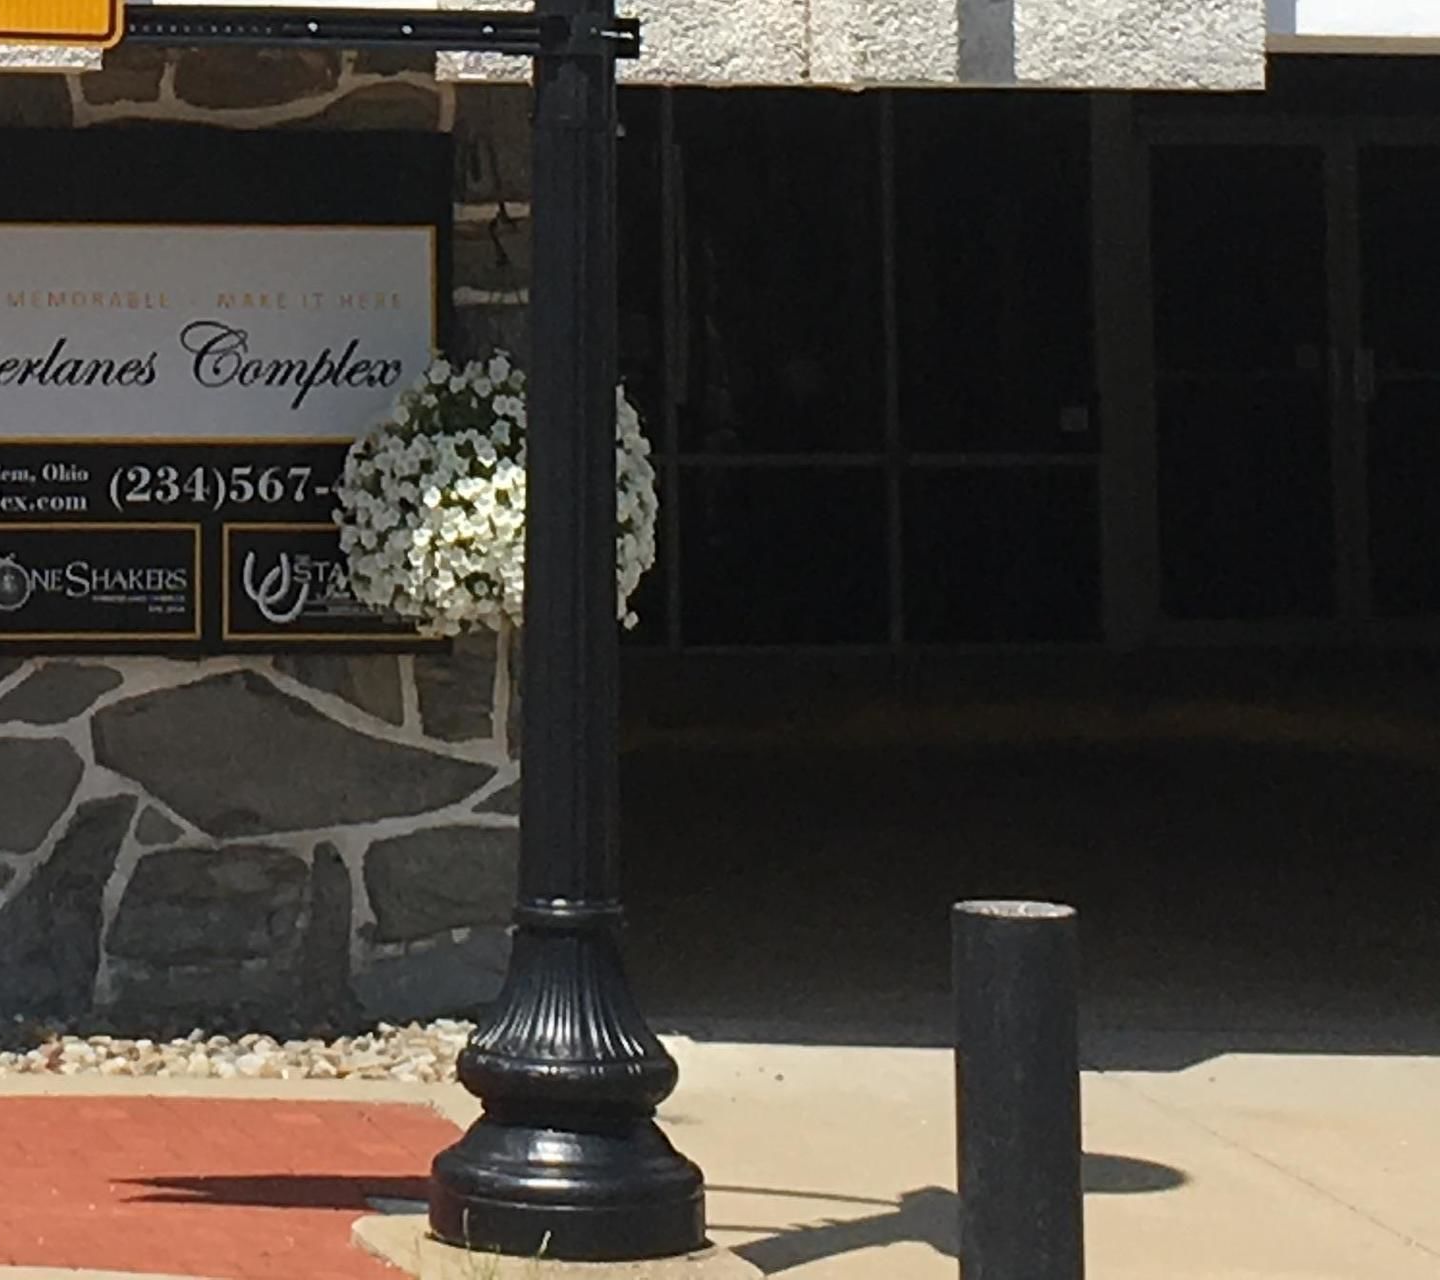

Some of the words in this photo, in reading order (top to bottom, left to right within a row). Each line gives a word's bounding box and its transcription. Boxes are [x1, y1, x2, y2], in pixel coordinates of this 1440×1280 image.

[6, 291, 171, 309] MEMORABLE
[216, 292, 288, 309] MAKE
[301, 293, 326, 309] IT
[340, 293, 402, 309] HERE
[179, 320, 403, 410] Complex
[42, 463, 90, 483] Ohio
[109, 464, 335, 512] (234)567-
